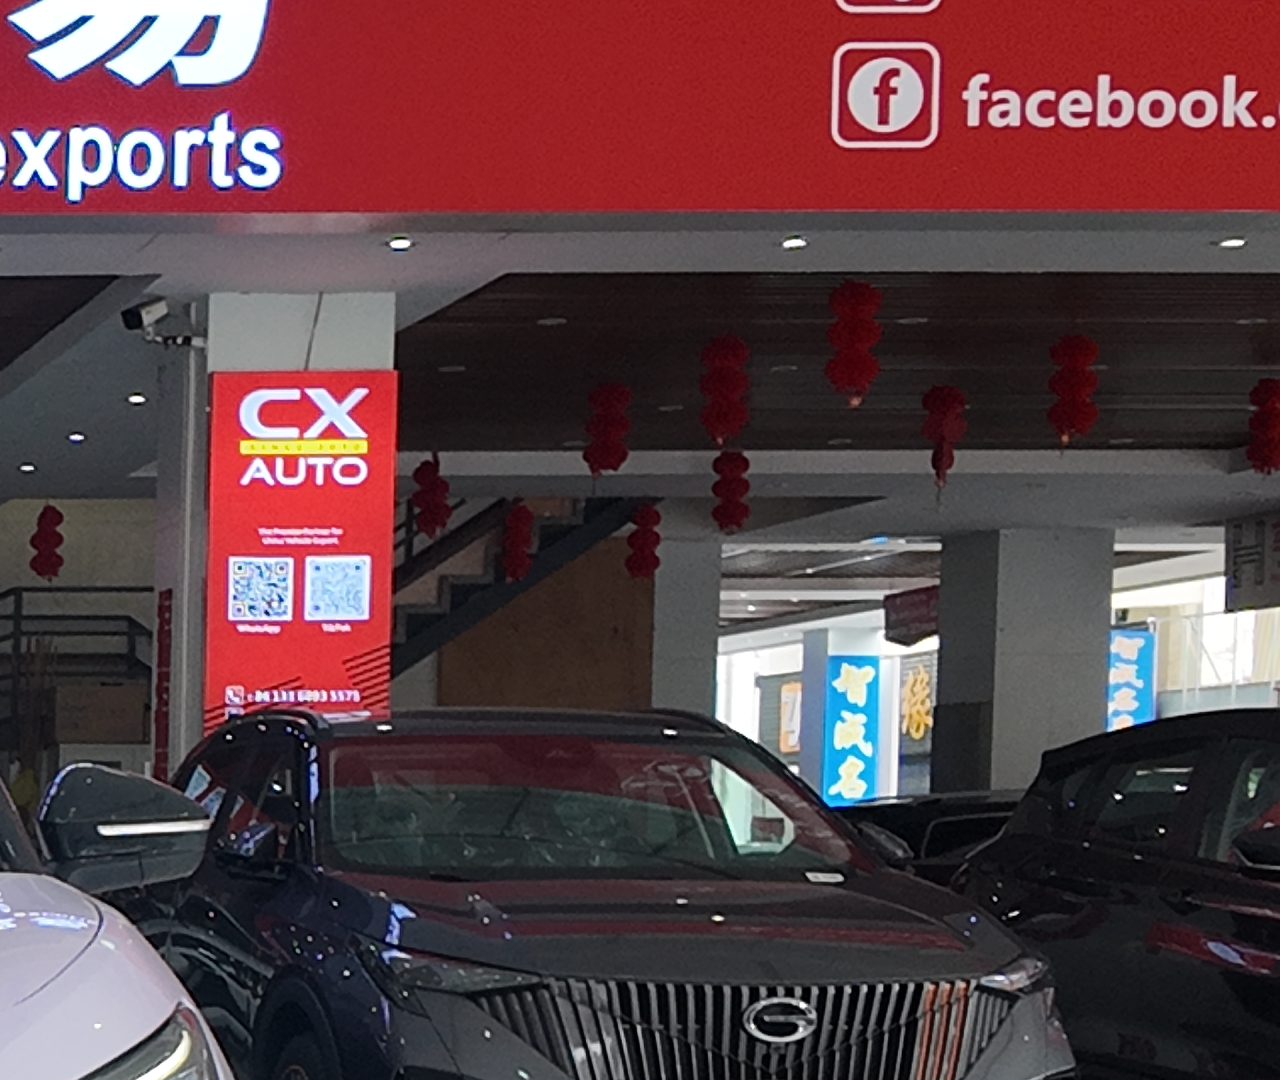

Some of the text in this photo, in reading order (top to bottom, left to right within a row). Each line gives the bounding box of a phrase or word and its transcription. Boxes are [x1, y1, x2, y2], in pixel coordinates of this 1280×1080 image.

[961, 73, 1280, 128] facebook.
[239, 387, 370, 438] CX
[240, 456, 369, 486] AUTO
